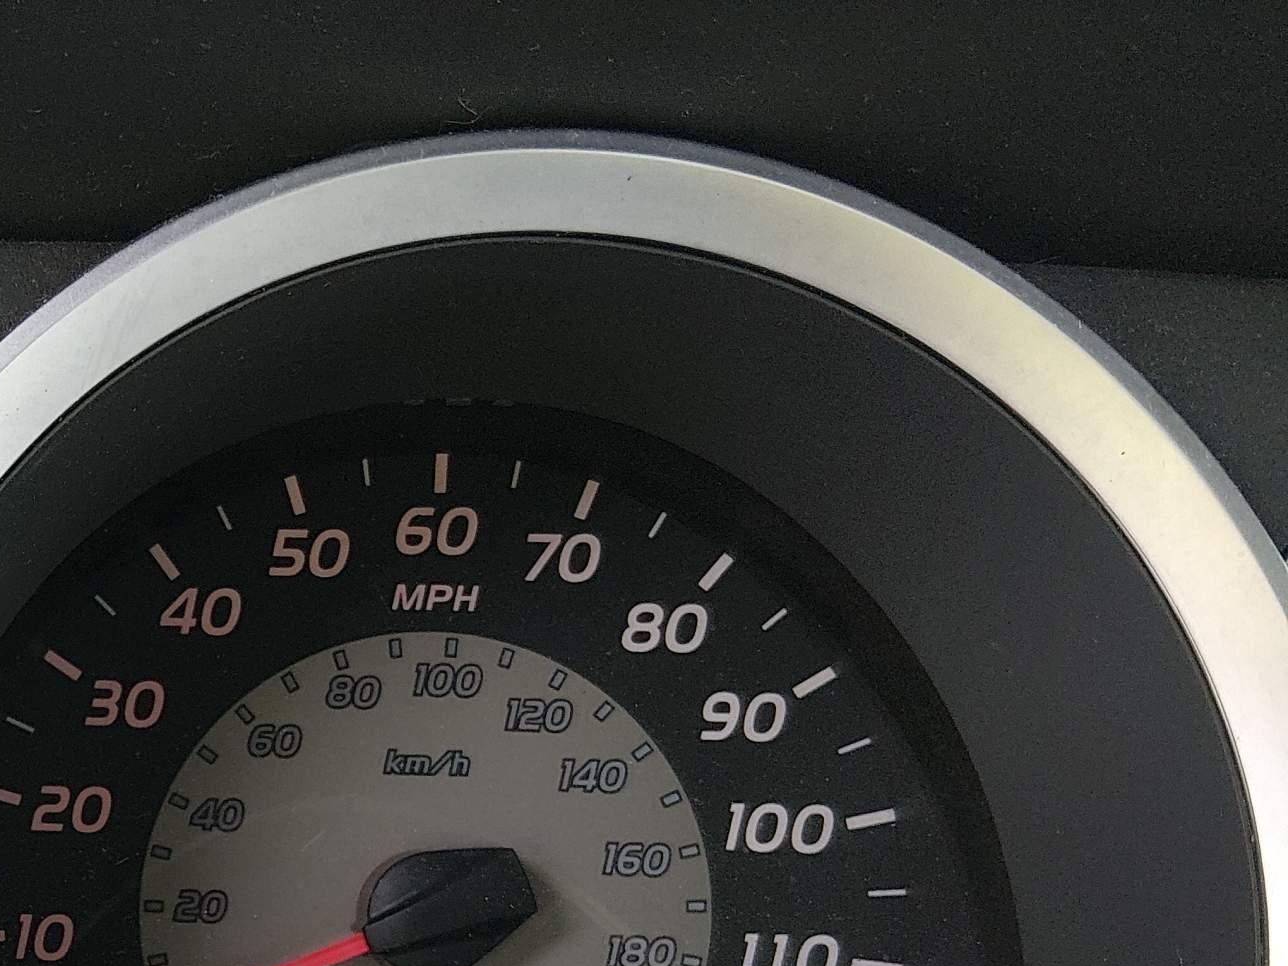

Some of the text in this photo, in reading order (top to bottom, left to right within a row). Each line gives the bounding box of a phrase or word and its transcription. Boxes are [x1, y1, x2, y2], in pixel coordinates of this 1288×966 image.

[395, 507, 479, 556] 60
[268, 528, 350, 578] 50
[524, 532, 601, 584] 70
[159, 587, 242, 637] 40
[391, 584, 480, 613] MPH
[621, 603, 708, 654] 80
[325, 675, 382, 710] 80
[413, 663, 483, 698] 100
[84, 680, 165, 729] 30
[505, 698, 573, 733] 120
[699, 691, 787, 742] 90
[247, 724, 302, 758] 60
[383, 748, 470, 777] km/h
[558, 759, 628, 794] 140
[30, 785, 112, 834] 20
[188, 797, 245, 832] 40
[724, 802, 835, 855] 100
[602, 842, 671, 878] 160
[172, 889, 229, 924] 20
[15, 914, 74, 962] 10
